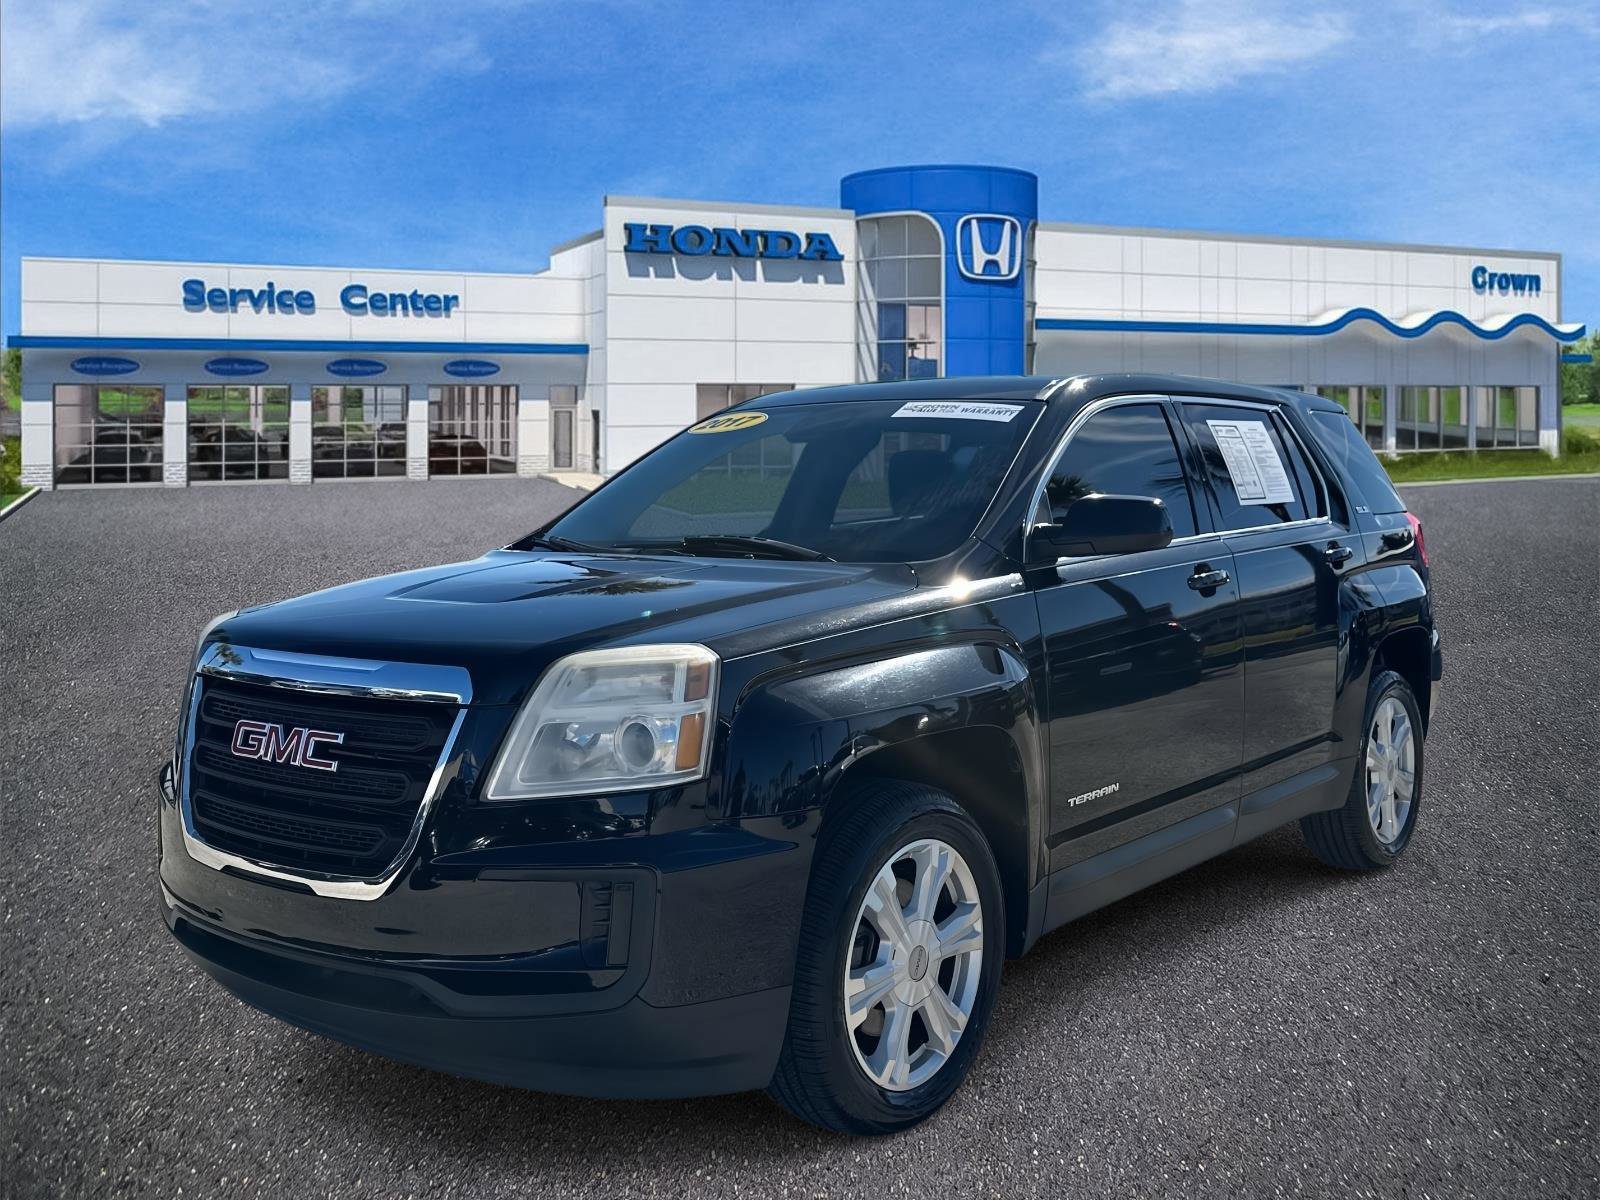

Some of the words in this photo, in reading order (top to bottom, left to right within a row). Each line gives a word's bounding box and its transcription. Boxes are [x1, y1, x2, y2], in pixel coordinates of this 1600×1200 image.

[624, 223, 844, 261] HONDA
[1472, 265, 1541, 292] Crown
[183, 279, 315, 311] Service
[340, 284, 459, 314] Center
[692, 415, 763, 431] 2017
[961, 407, 1016, 416] WARRANTY
[231, 720, 345, 772] GMC
[1068, 783, 1119, 807] TERRAIN
